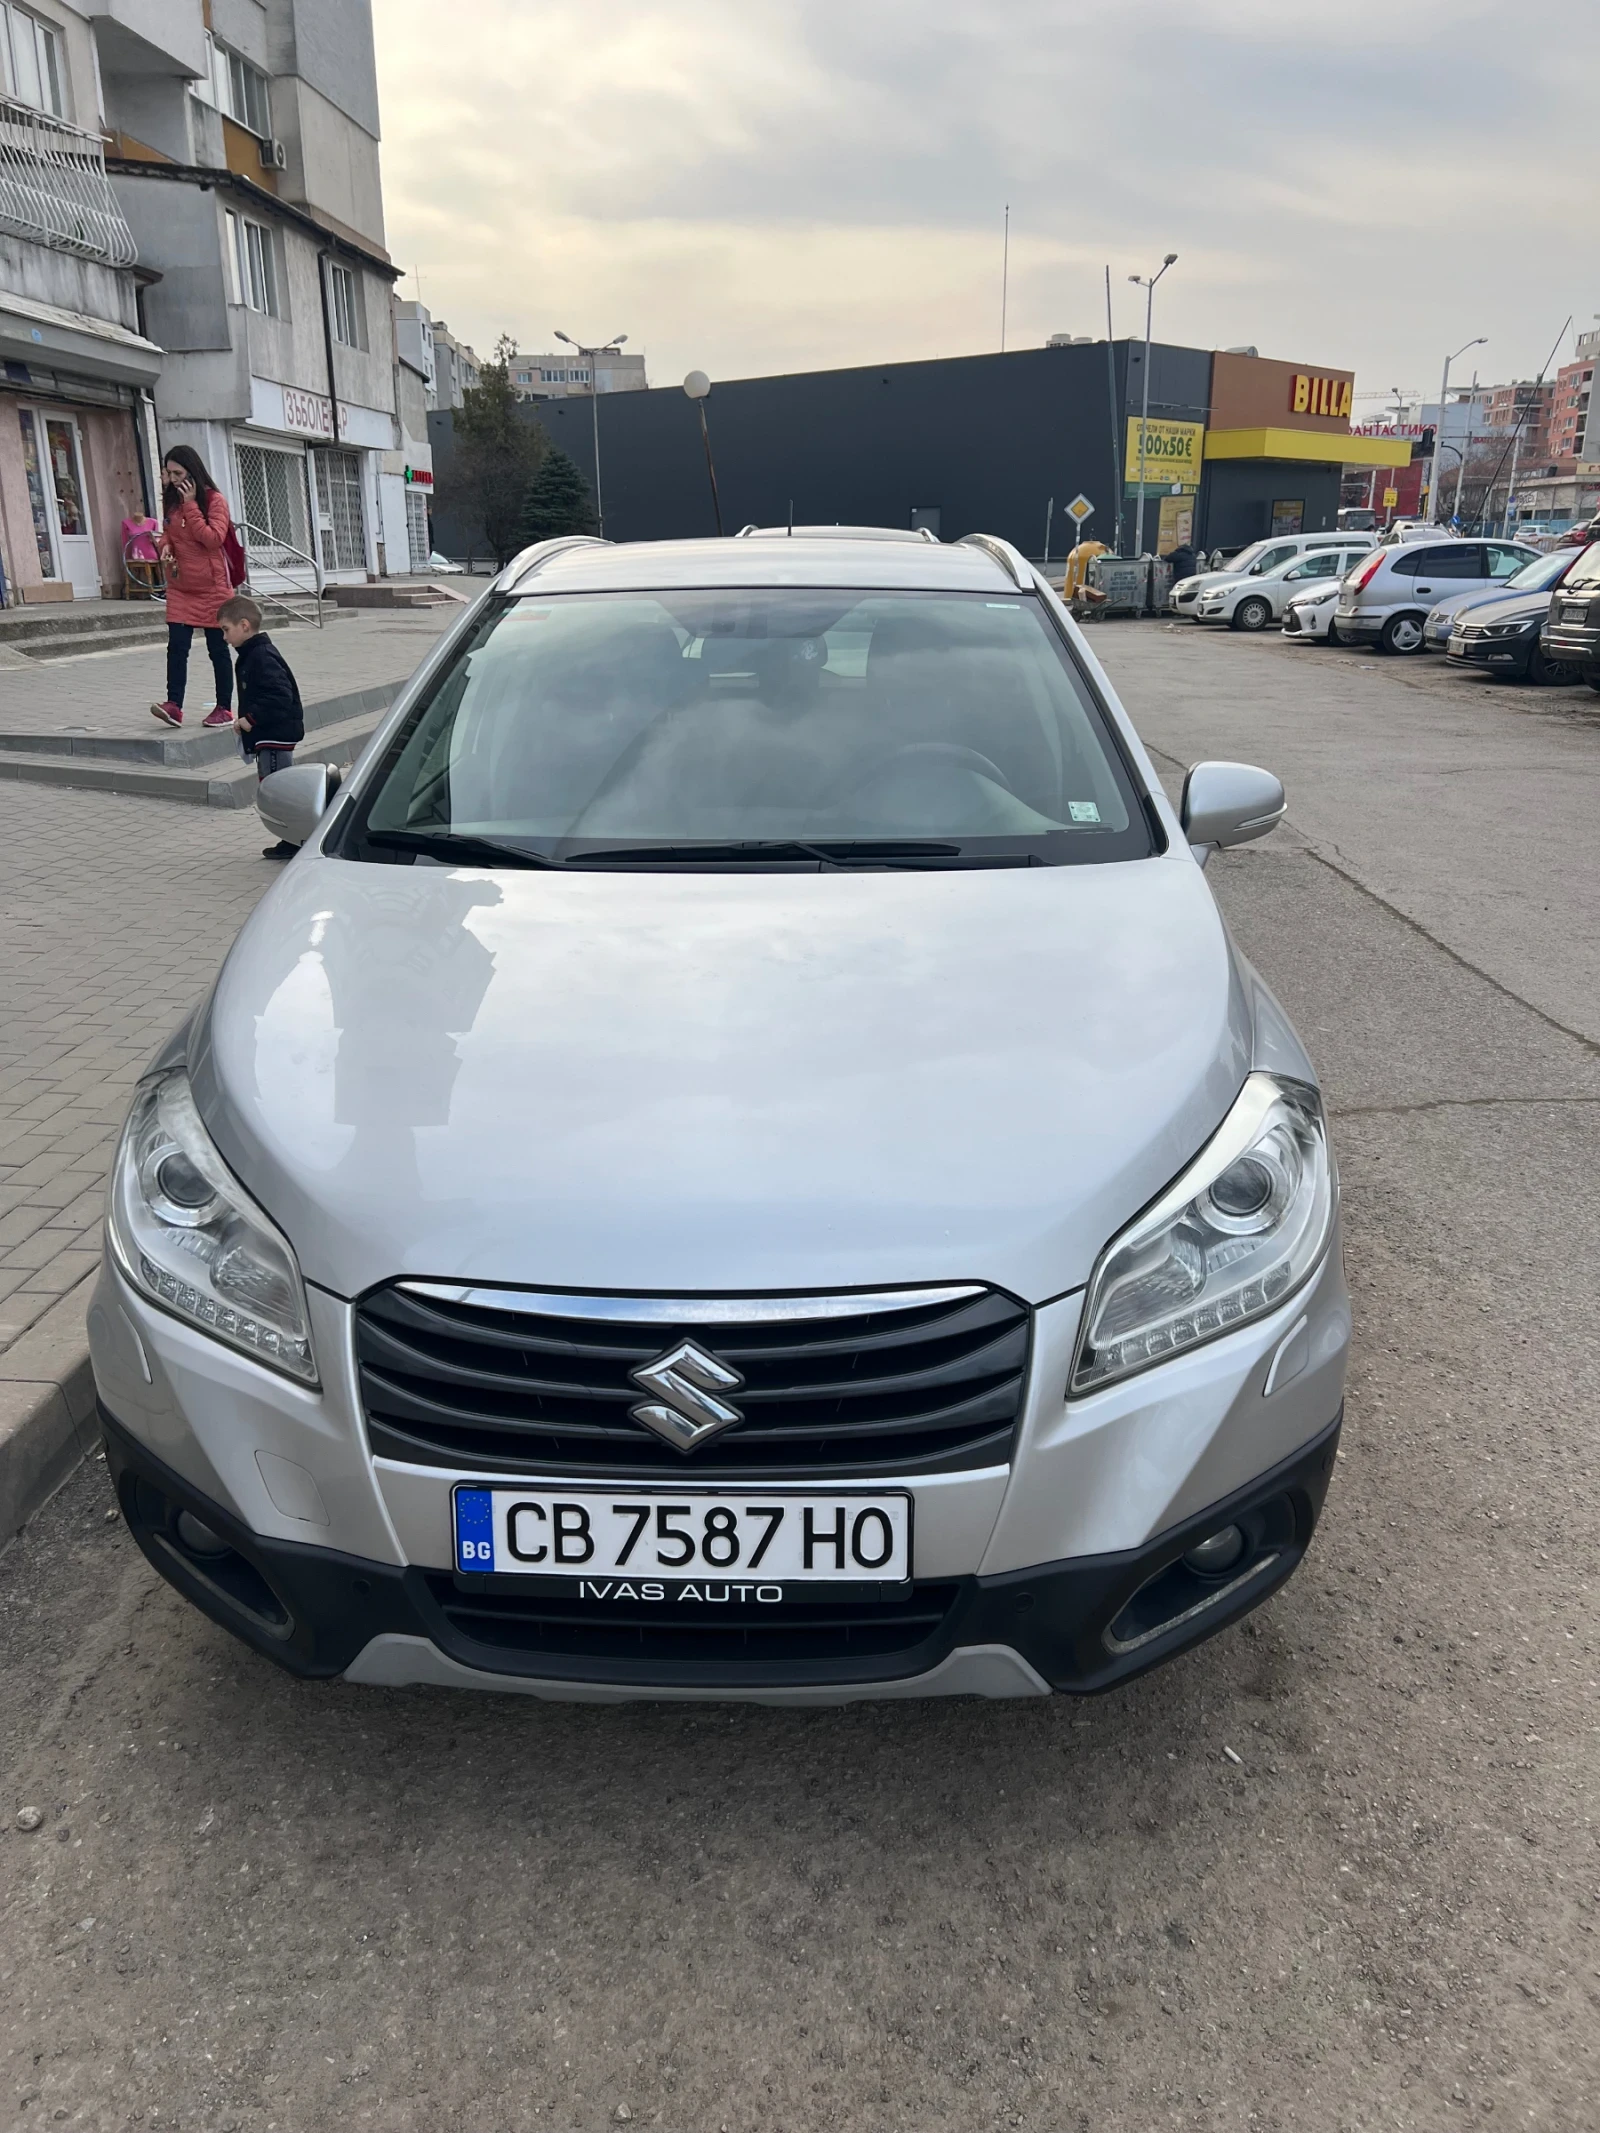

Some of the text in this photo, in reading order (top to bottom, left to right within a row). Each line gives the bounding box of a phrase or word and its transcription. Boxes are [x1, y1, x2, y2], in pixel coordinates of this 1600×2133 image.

[1290, 374, 1352, 418] BILLA
[462, 1541, 491, 1560] BG
[506, 1501, 595, 1564] CB
[612, 1504, 785, 1569] 7587
[579, 1581, 783, 1603] IVAS AUTO
